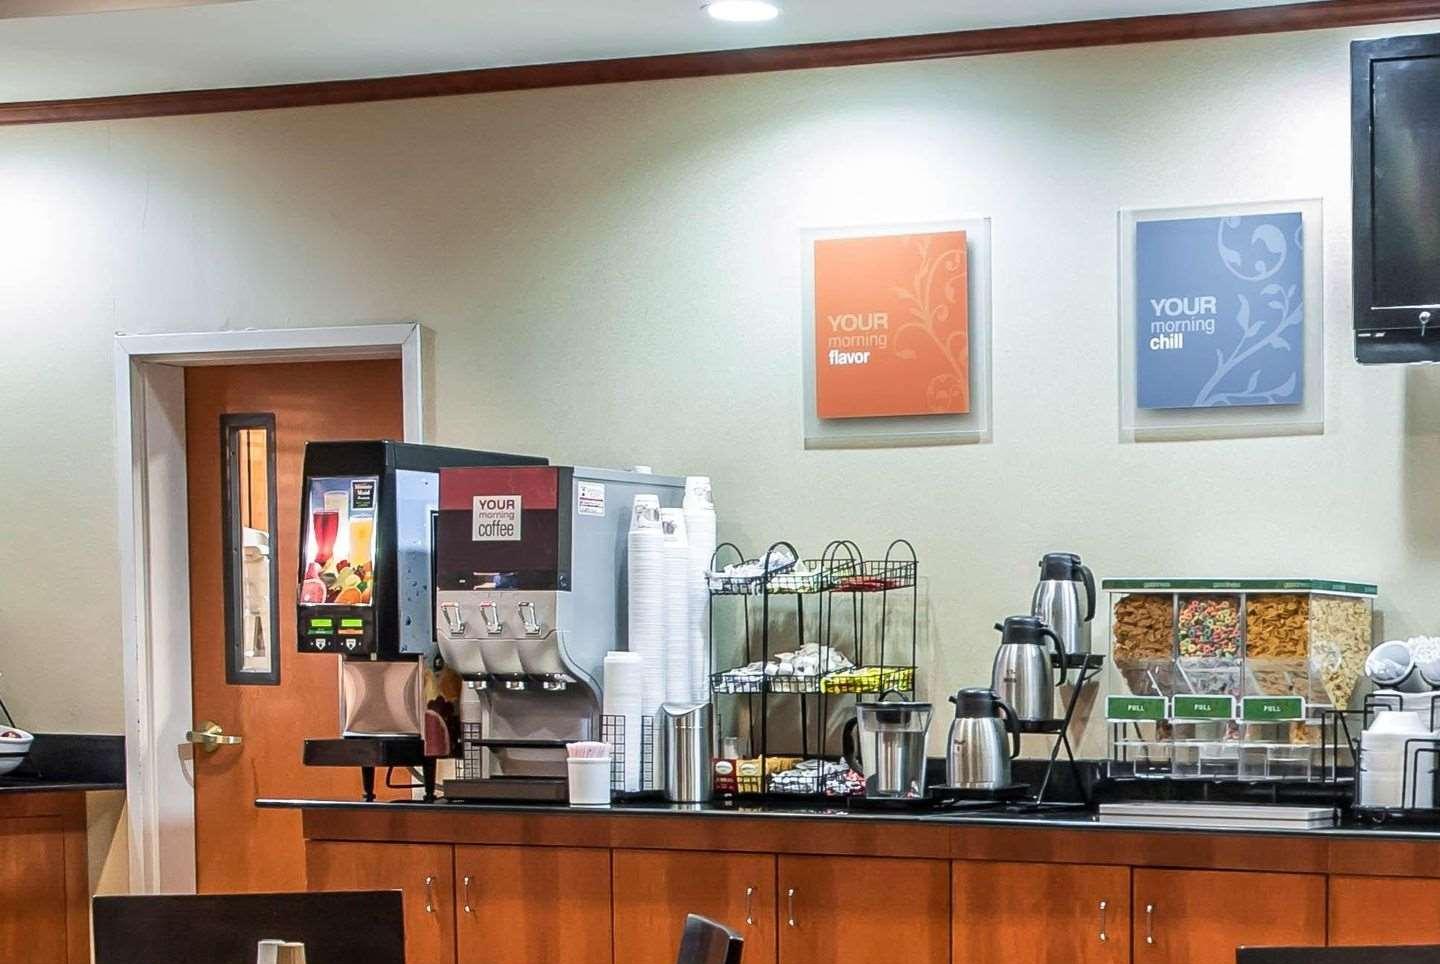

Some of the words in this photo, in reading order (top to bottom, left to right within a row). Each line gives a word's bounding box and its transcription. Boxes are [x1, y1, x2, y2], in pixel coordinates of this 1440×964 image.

[1150, 296, 1217, 316] YOUR
[827, 313, 889, 331] YOUR
[1151, 316, 1215, 334] morning
[828, 332, 888, 349] morning
[1150, 333, 1183, 350] chill
[828, 350, 870, 365] flavor
[479, 500, 515, 510] YOUR
[479, 510, 515, 521] morning
[478, 520, 514, 537] coffee
[1194, 703, 1211, 711] PULL
